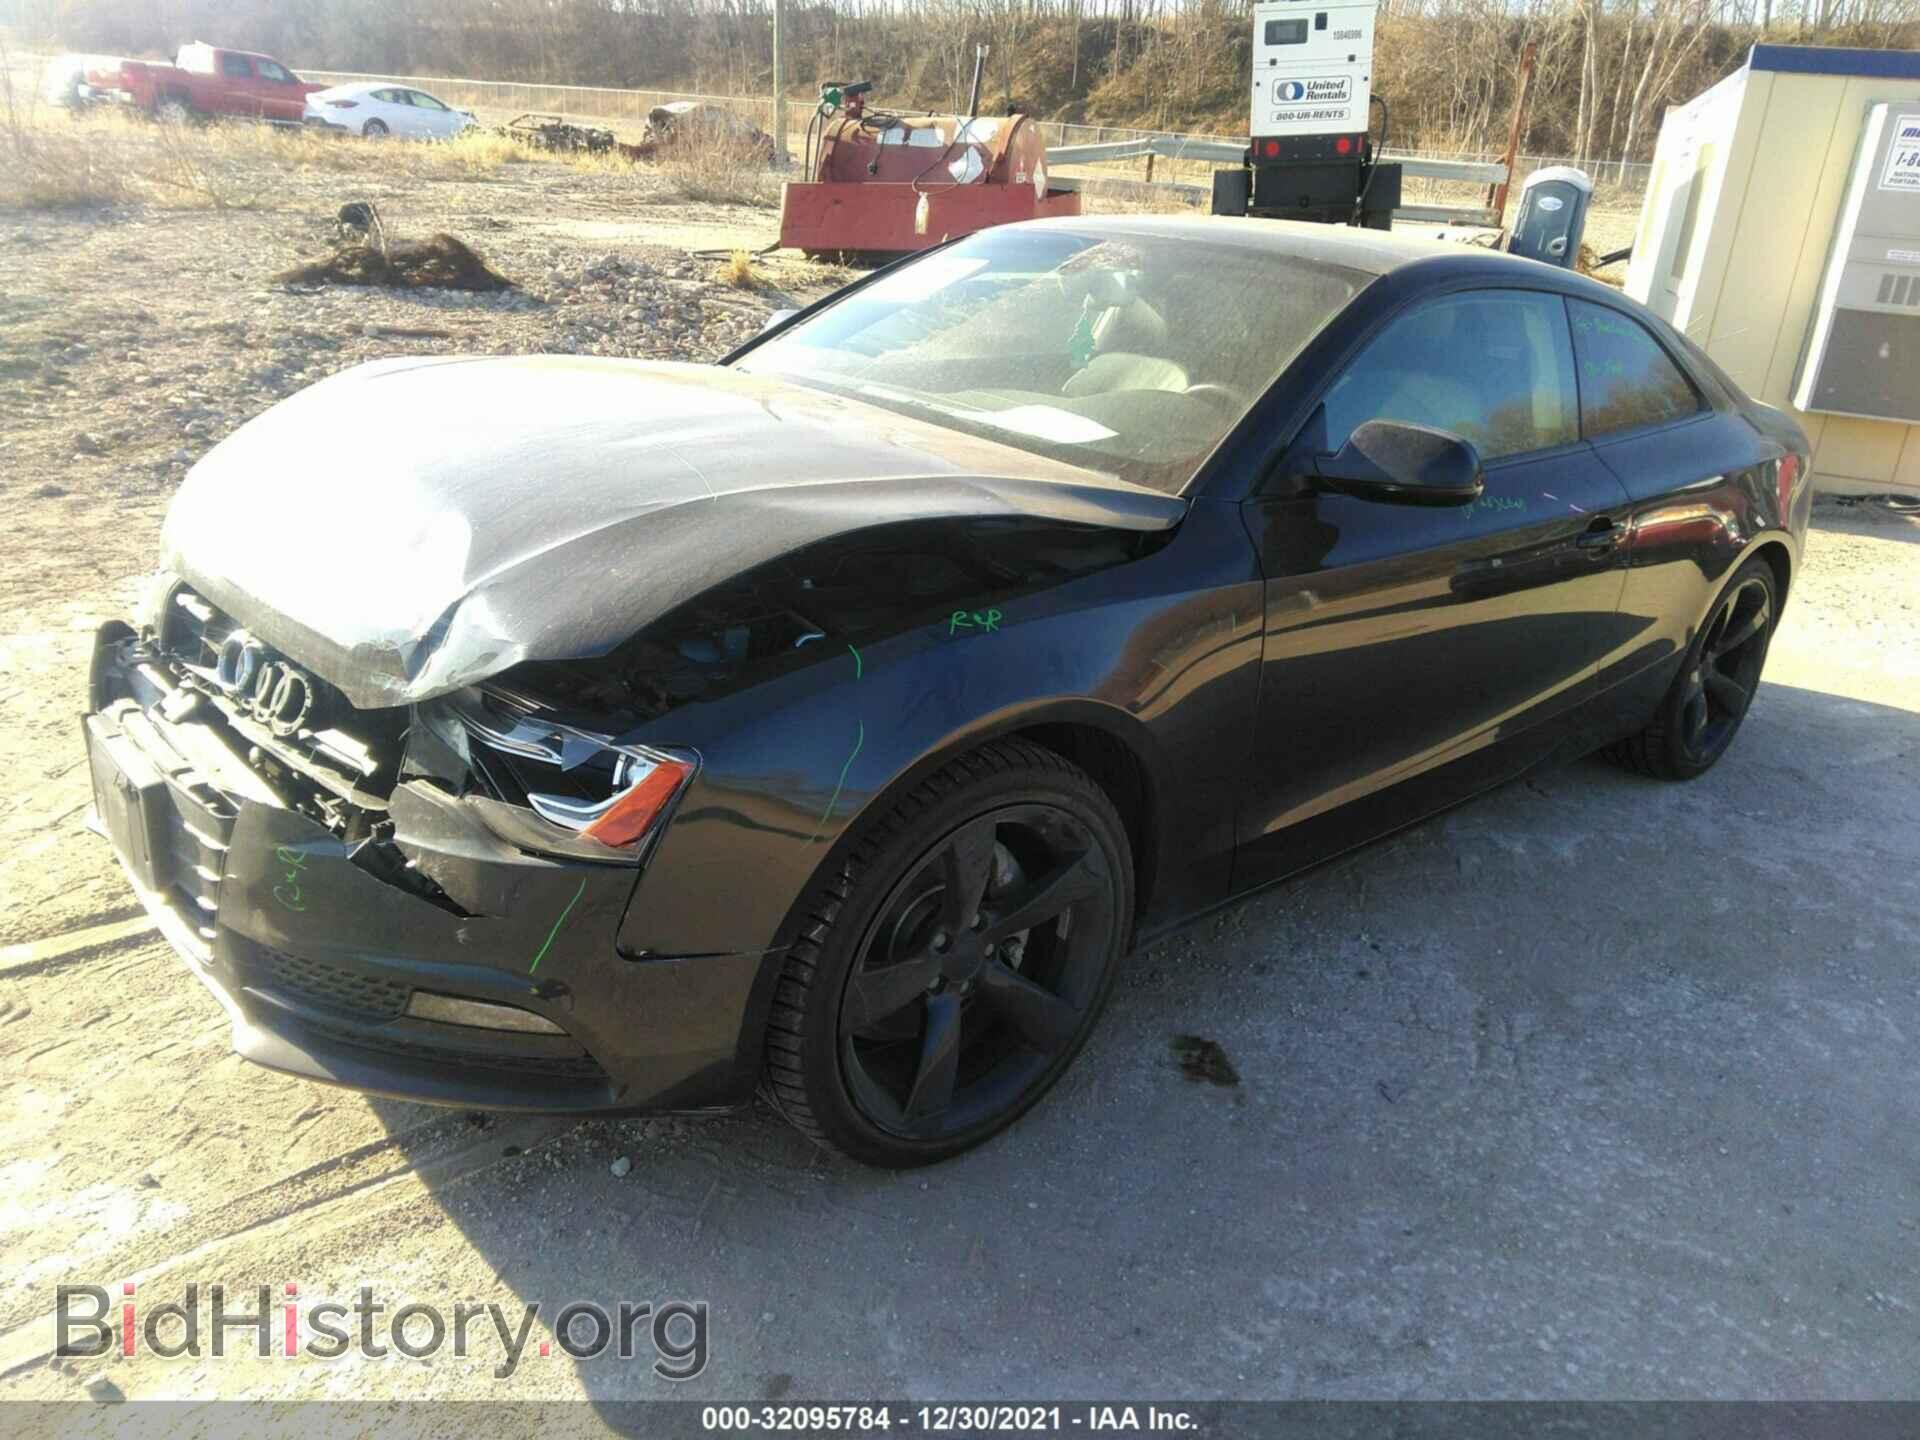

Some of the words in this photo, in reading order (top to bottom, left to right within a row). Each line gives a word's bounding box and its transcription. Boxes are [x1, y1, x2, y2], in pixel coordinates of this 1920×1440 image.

[1307, 80, 1344, 91] United
[1306, 91, 1347, 101] Rentals
[1276, 110, 1344, 121] 800-UR-RENTS
